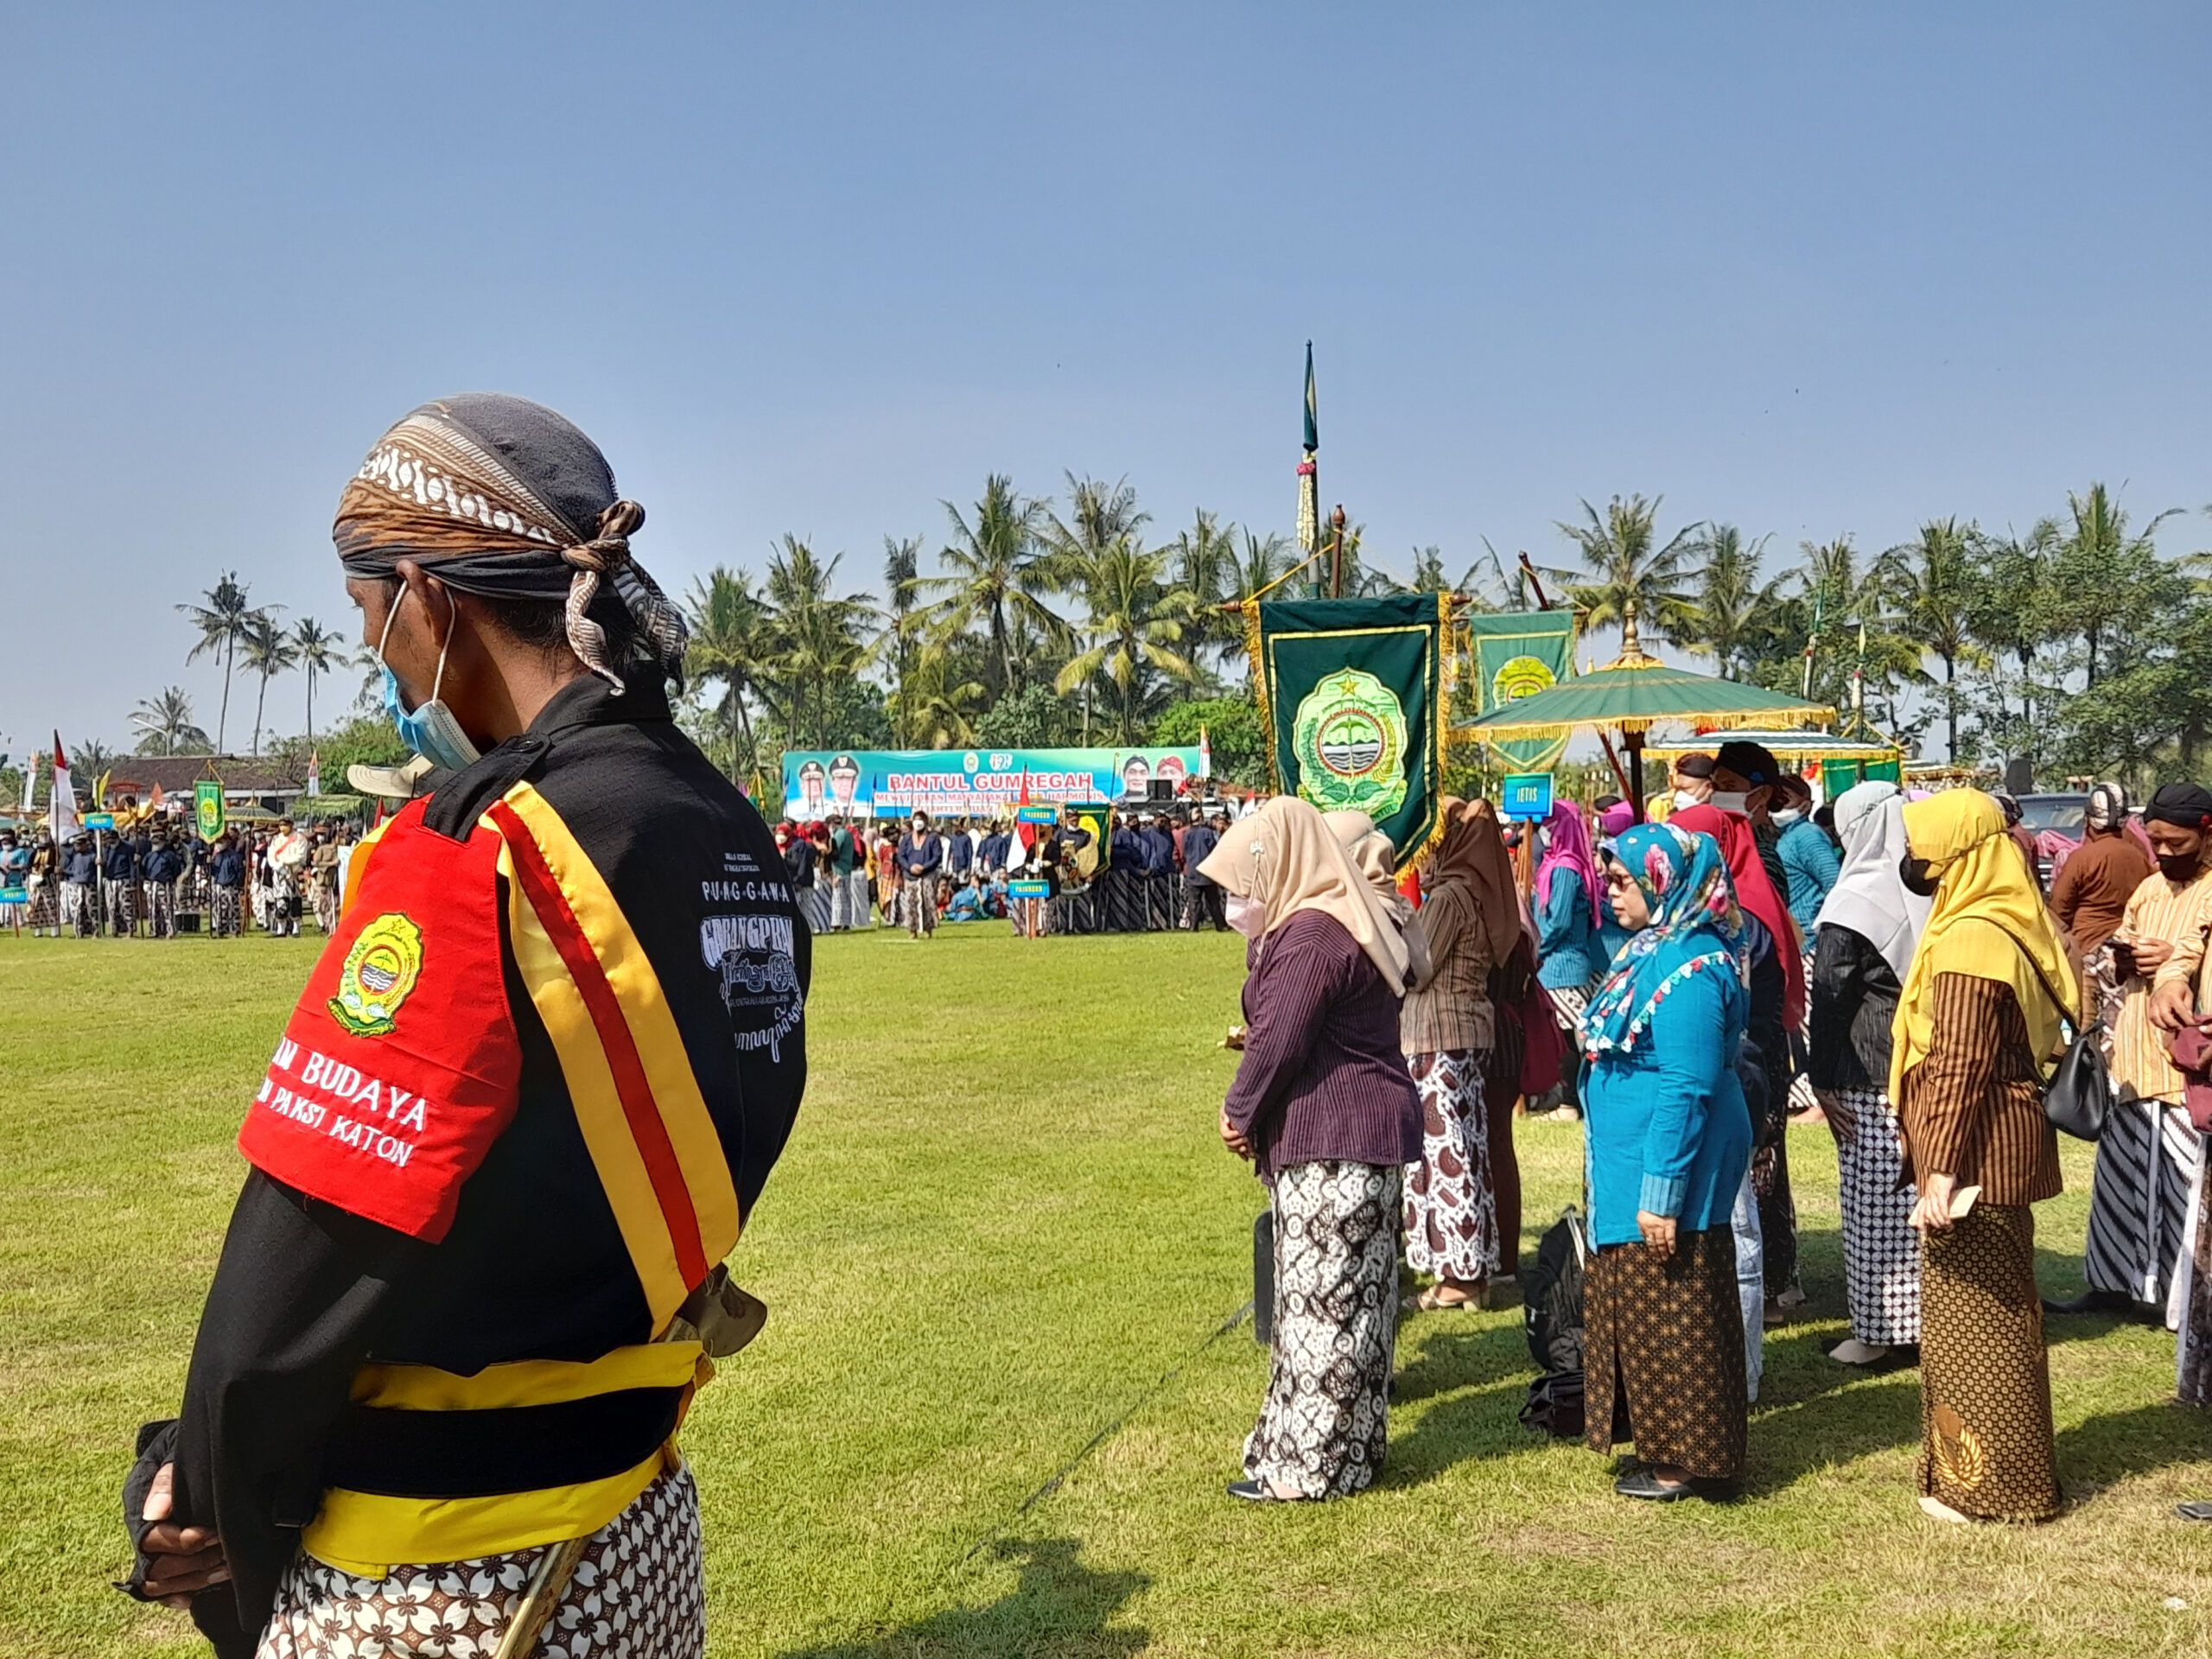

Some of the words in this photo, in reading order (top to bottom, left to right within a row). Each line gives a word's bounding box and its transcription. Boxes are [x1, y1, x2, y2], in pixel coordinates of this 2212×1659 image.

[889, 775, 969, 790] BANTUL
[976, 773, 1091, 789] GUMREGAH
[270, 1086, 327, 1128] PAKSI
[328, 1115, 414, 1167] KATON
[301, 1051, 429, 1132] BUDAYA
